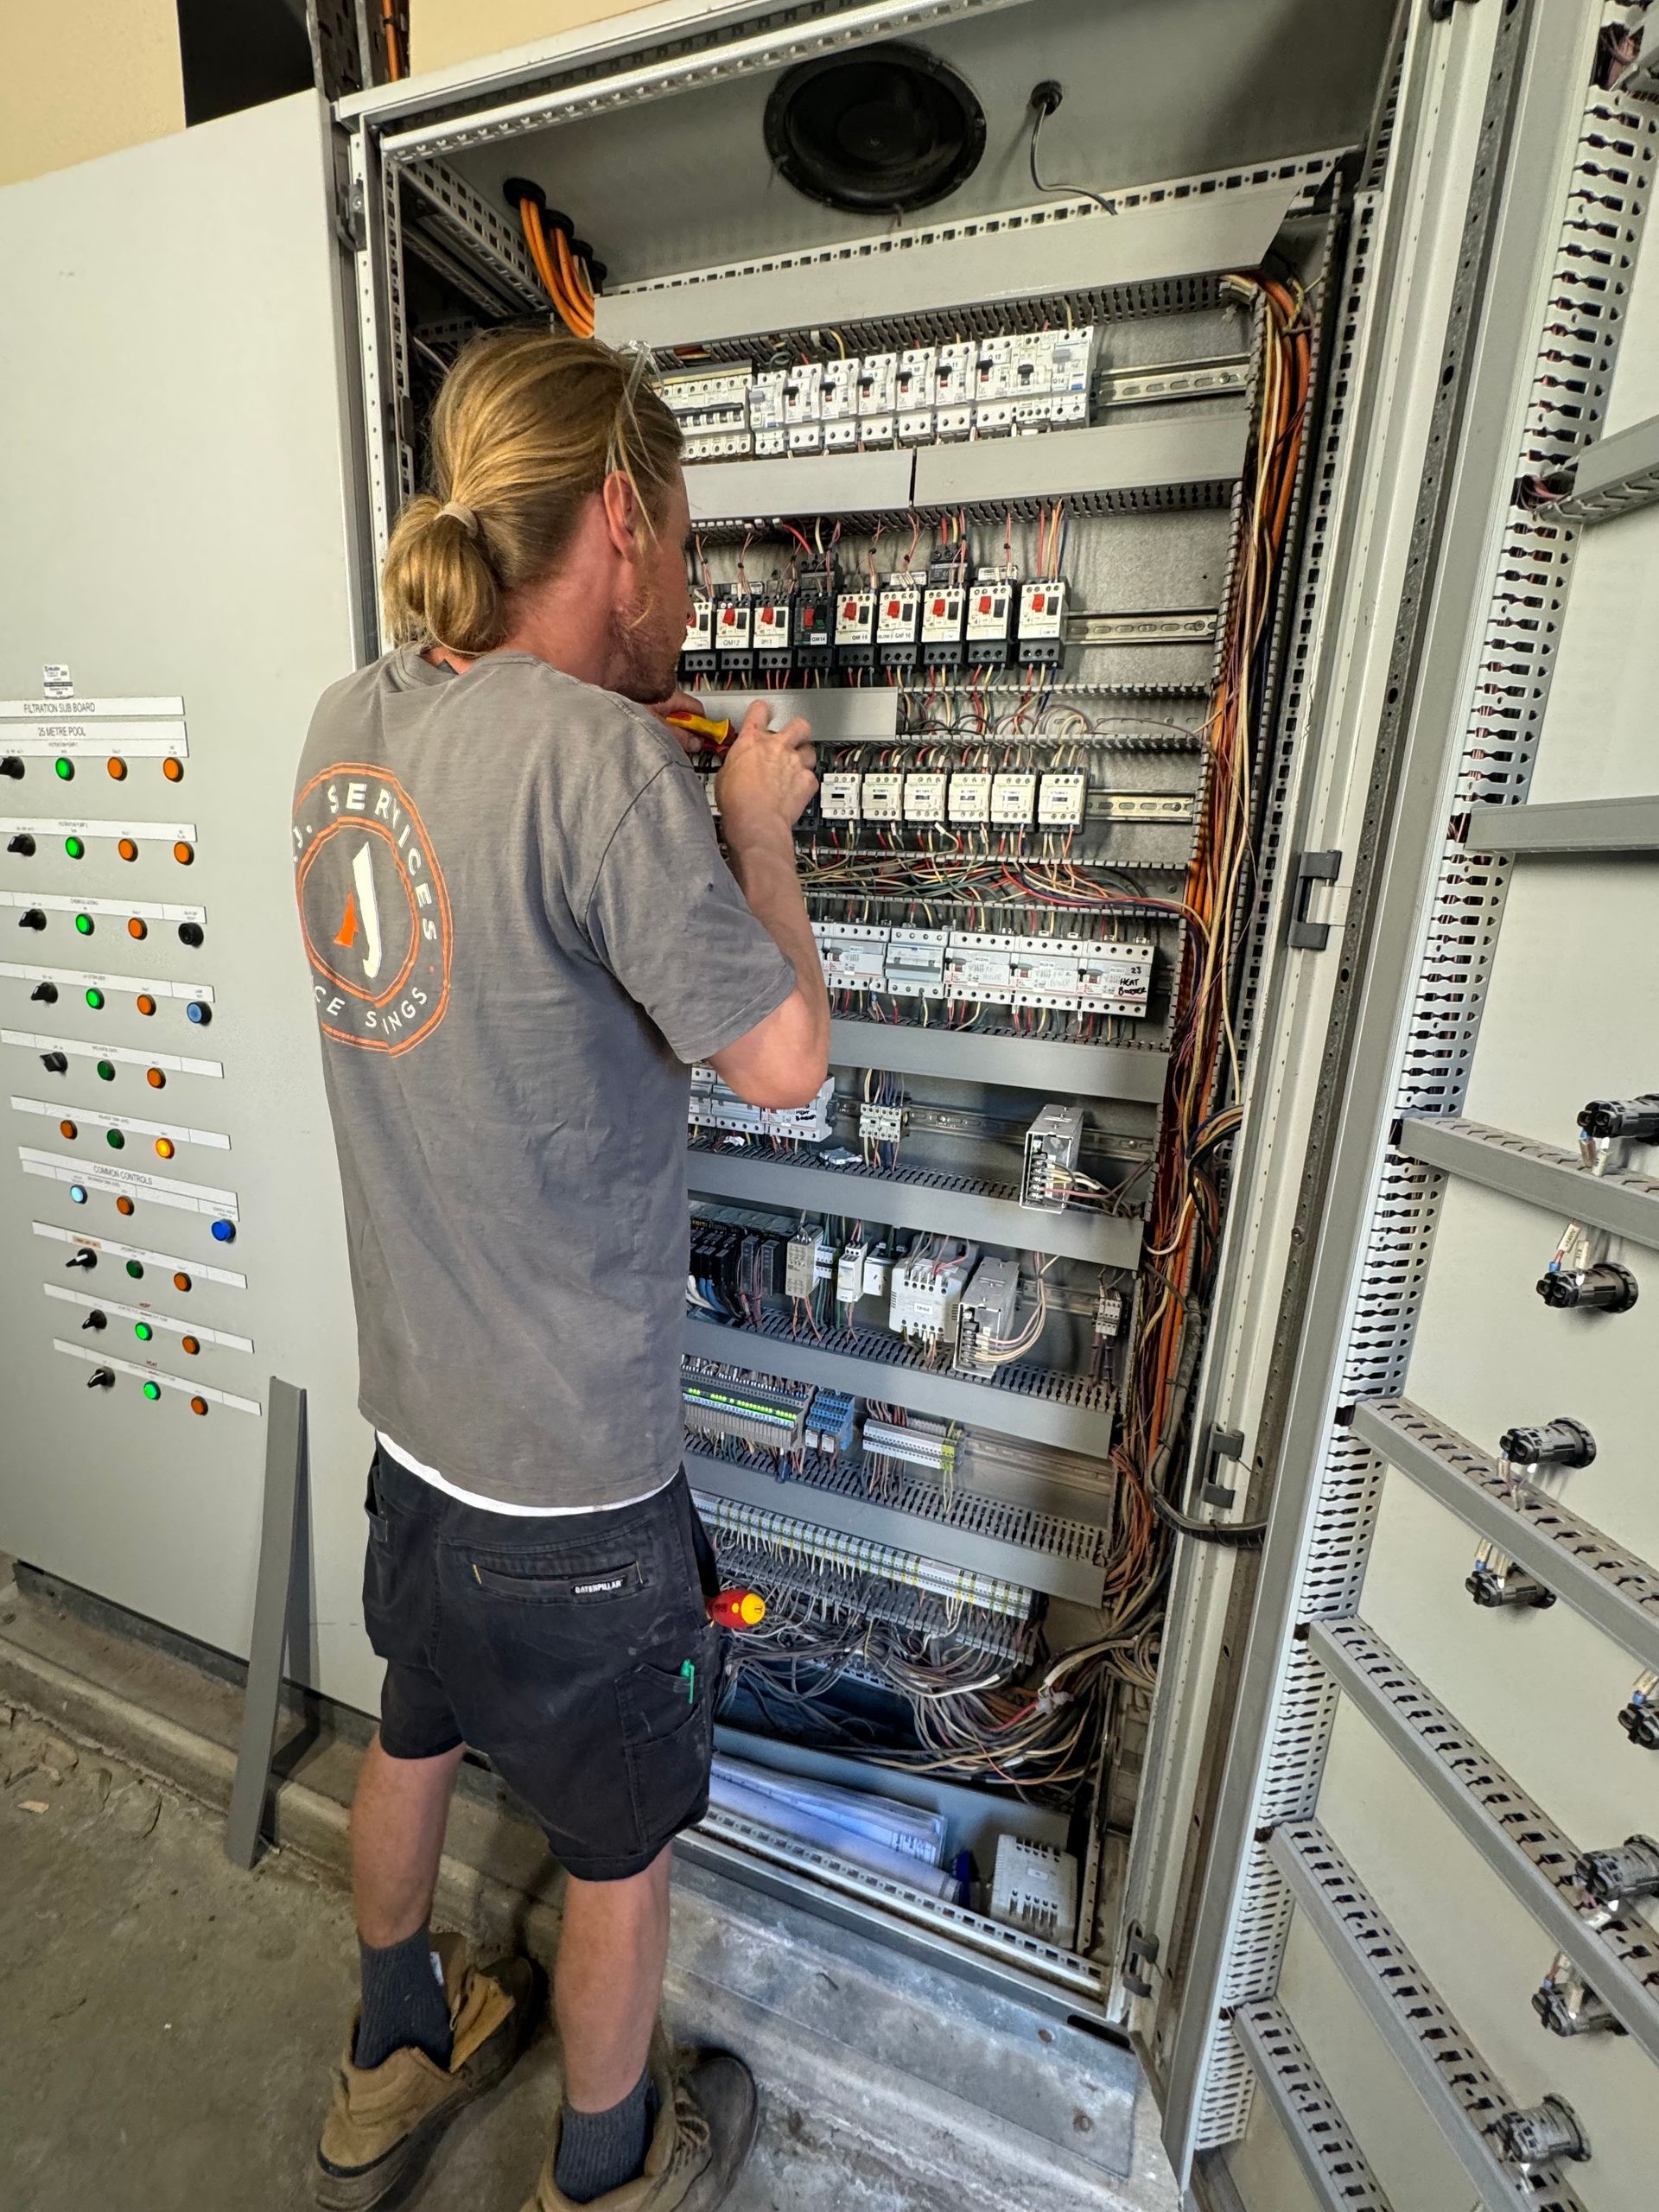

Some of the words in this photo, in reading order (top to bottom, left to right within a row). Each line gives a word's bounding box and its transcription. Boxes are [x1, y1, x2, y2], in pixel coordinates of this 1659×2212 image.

[24, 703, 58, 714] FILTRATION
[59, 703, 73, 713] SUB
[73, 702, 95, 712] BOARD
[47, 727, 67, 736] METRE
[68, 726, 86, 736] POOL
[327, 782, 438, 942] SERVICES
[365, 986, 429, 1036] SINGS
[93, 1165, 119, 1179] COMMON
[119, 1172, 153, 1185] CONTROLS
[575, 1580, 622, 1593] CATERPILLAR
